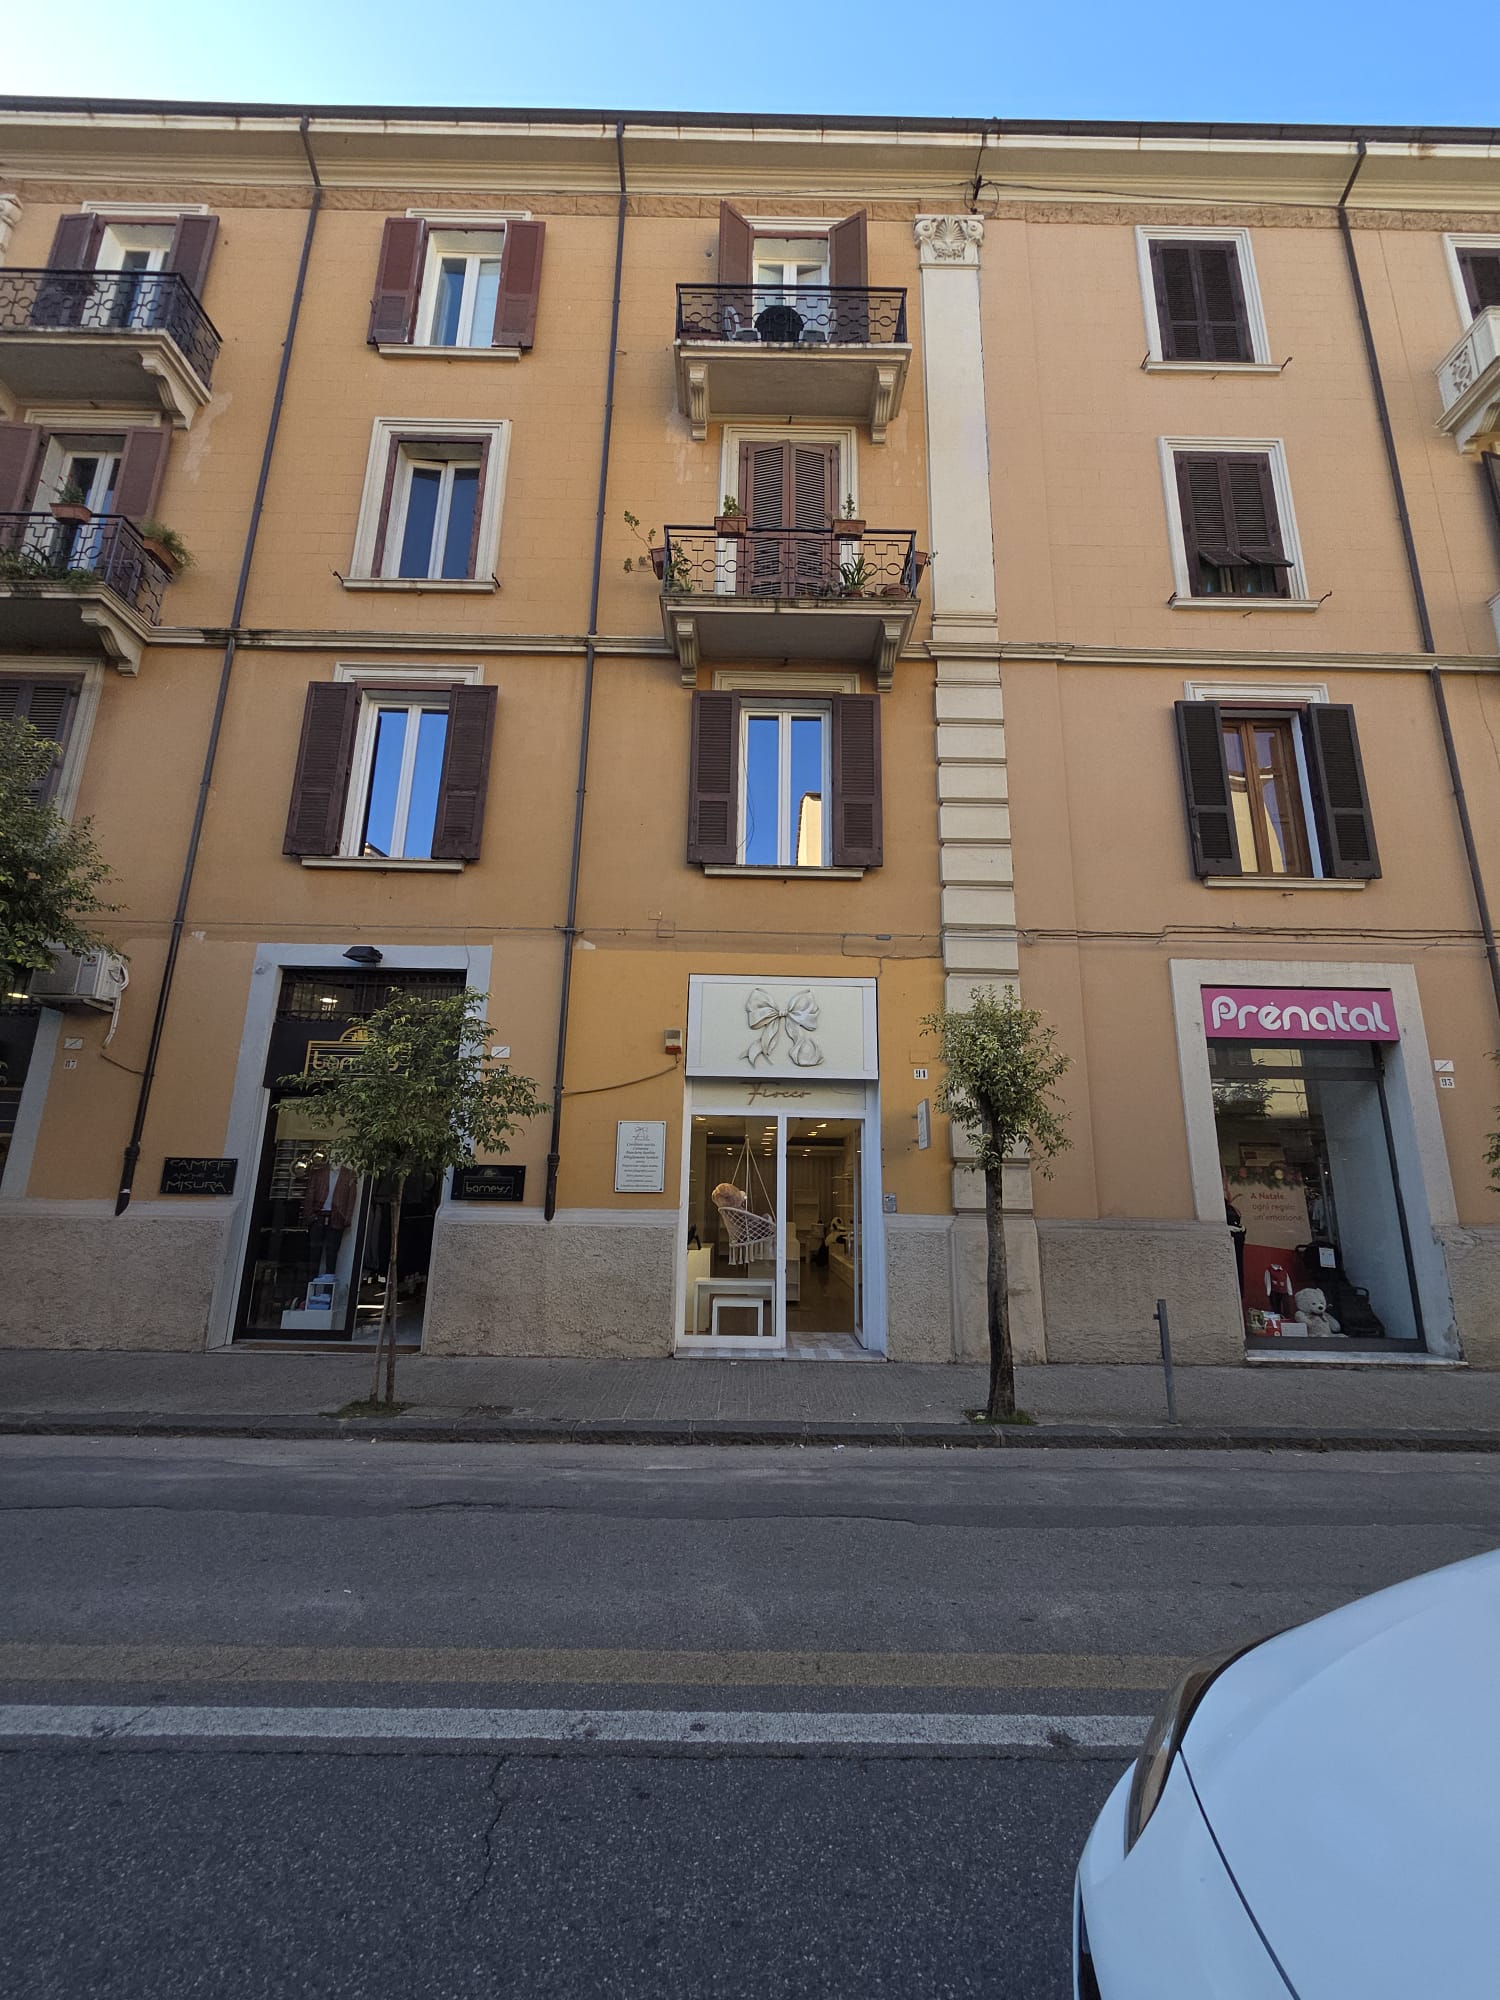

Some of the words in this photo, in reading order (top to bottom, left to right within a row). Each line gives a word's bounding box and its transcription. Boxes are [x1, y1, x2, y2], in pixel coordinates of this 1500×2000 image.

[915, 1069, 926, 1079] 91
[1441, 1078, 1453, 1087] 93
[166, 1181, 227, 1193] MISURA
